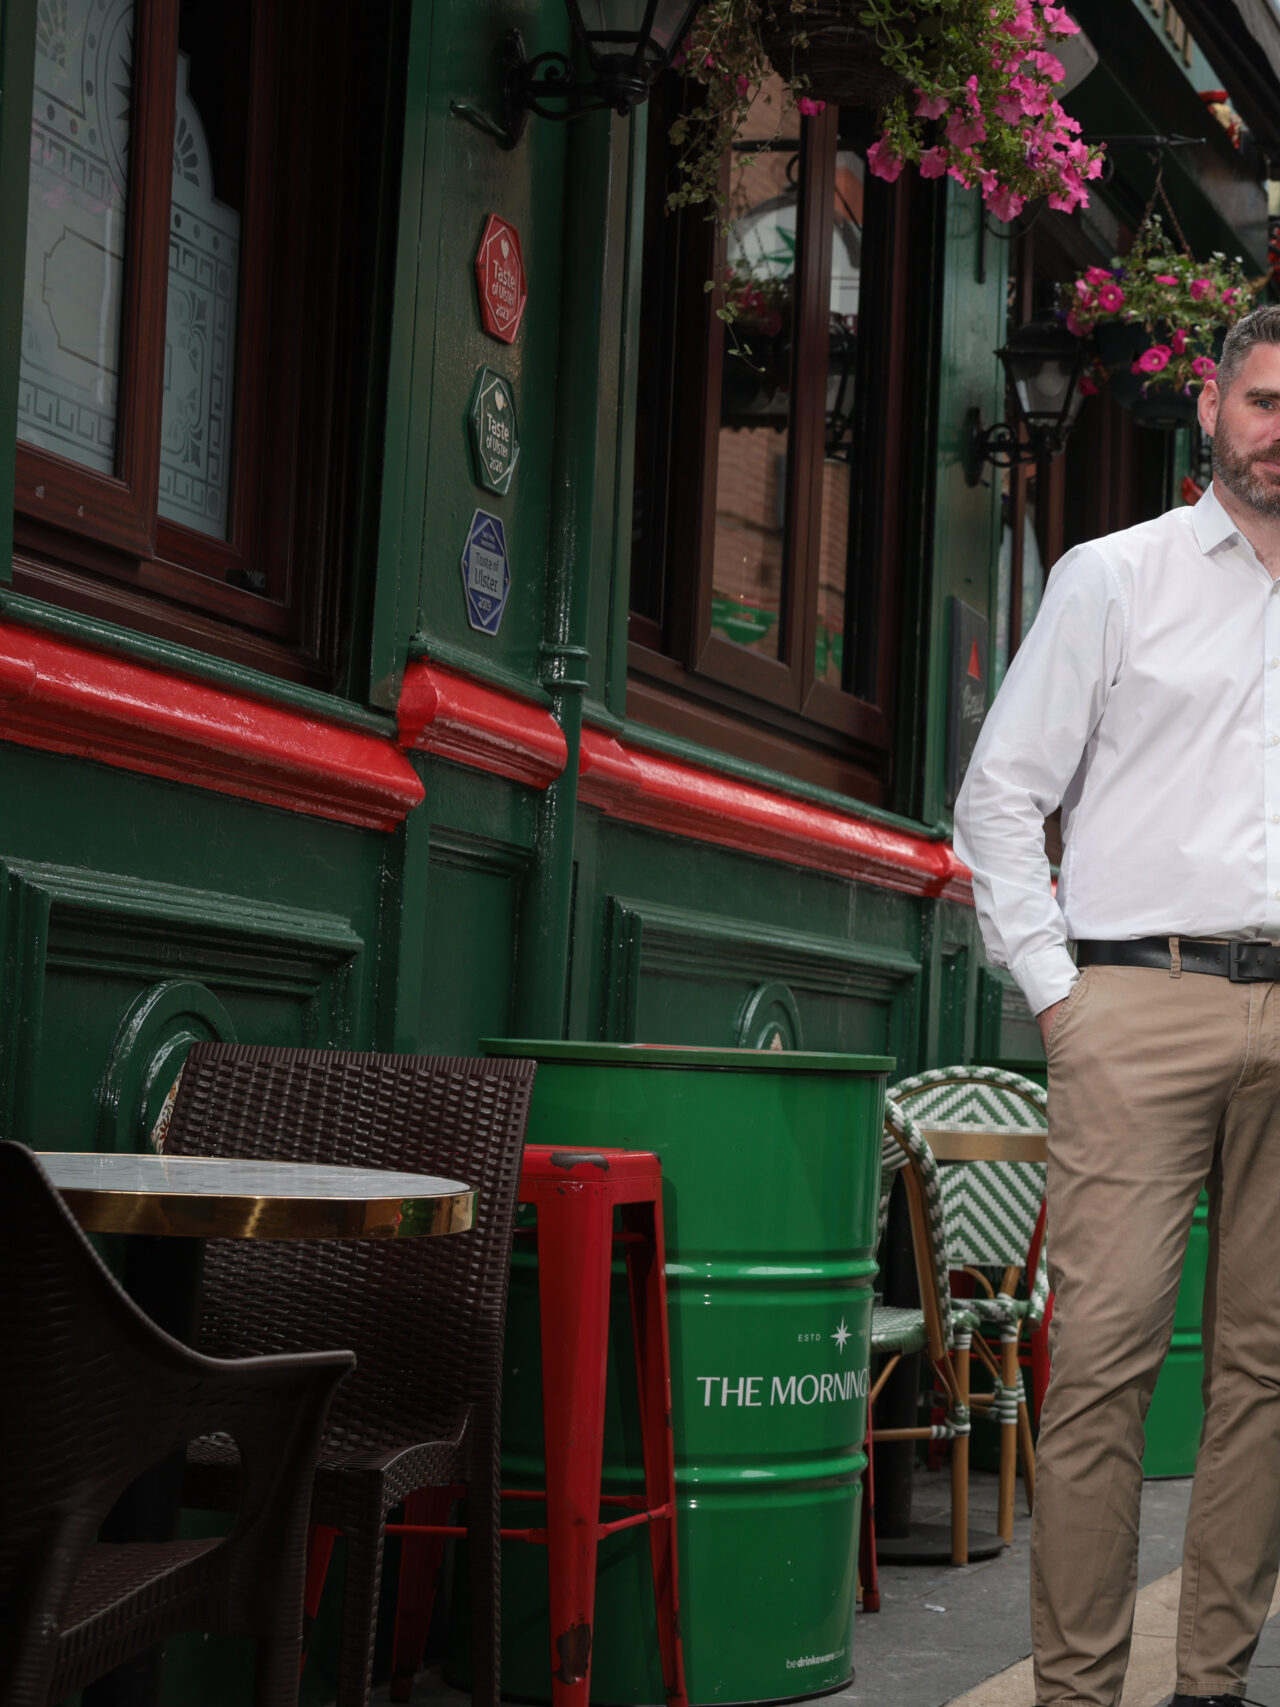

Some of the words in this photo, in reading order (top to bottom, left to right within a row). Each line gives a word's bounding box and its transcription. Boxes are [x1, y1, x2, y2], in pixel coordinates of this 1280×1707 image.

[493, 260, 515, 290] Taste
[487, 412, 510, 442] Taste
[493, 436, 509, 458] Ulster
[476, 551, 492, 570] Taste
[475, 568, 498, 593] Ulster
[798, 1333, 821, 1342] ESTD
[697, 1376, 763, 1407] THE
